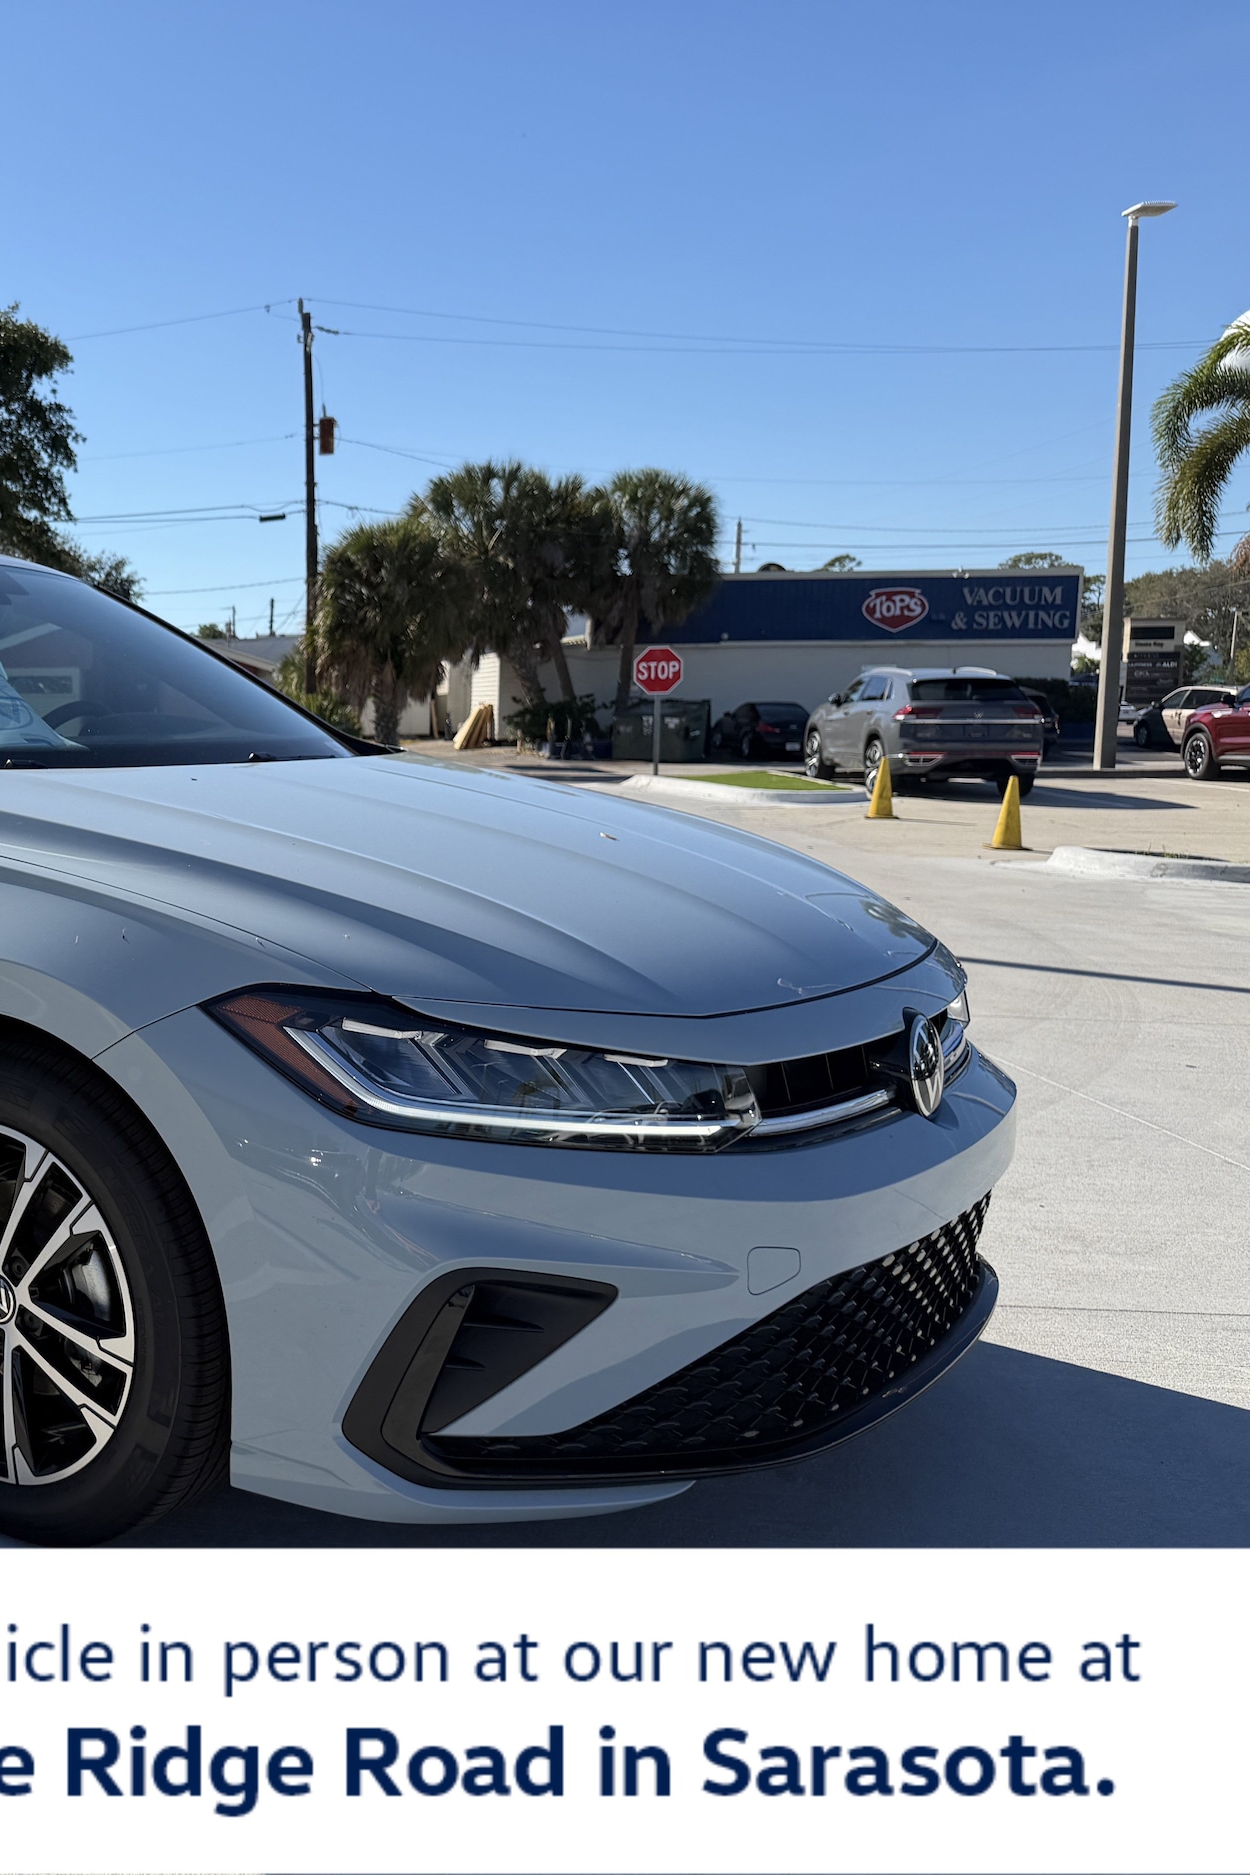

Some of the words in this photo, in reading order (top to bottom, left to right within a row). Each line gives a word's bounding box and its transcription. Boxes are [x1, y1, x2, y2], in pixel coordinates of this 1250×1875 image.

[962, 586, 1063, 606] VACUUM
[951, 611, 968, 630] &
[972, 609, 1070, 630] SEWING
[637, 660, 680, 680] STOP
